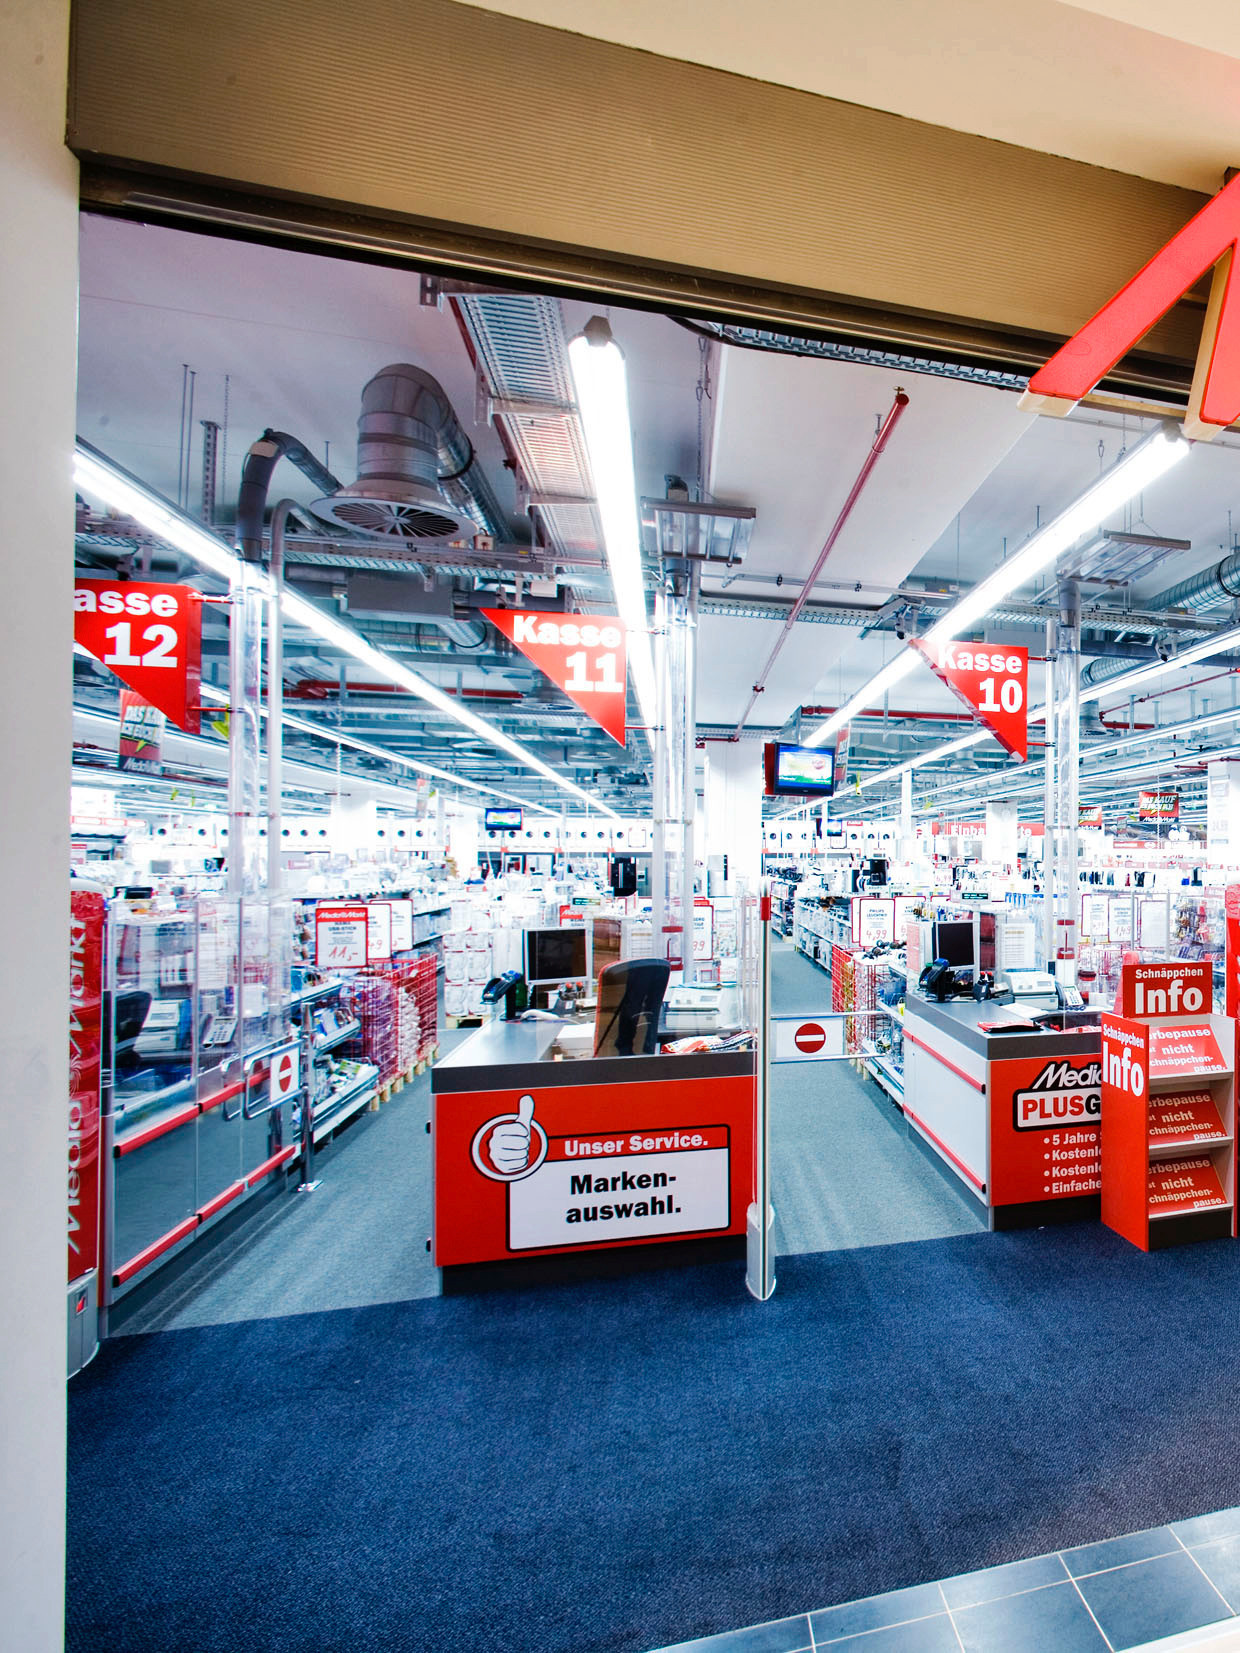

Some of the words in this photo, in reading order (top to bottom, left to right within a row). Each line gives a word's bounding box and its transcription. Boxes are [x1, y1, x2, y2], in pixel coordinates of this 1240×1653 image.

[74, 588, 179, 617] asse
[512, 613, 622, 649] Kasse
[104, 621, 178, 668] 12
[937, 641, 1023, 674] Kasse
[563, 651, 625, 693] 11
[977, 675, 1025, 714] 10
[1135, 967, 1204, 980] Schnäppchen
[1135, 979, 1204, 1014] Info
[1103, 1023, 1145, 1049] Schnäppchen
[1149, 1027, 1211, 1041] erbepause
[1149, 1054, 1214, 1067] chnäppchen-
[1161, 1043, 1195, 1055] nicht
[1102, 1041, 1145, 1097] Info
[1022, 1094, 1102, 1121] PLUSG
[1148, 1093, 1211, 1109] erbepause
[1149, 1122, 1214, 1135] chnäppchen-
[1161, 1110, 1195, 1123] nicht
[564, 1136, 625, 1157] Unser
[629, 1131, 710, 1153] Service.
[1052, 1134, 1060, 1145] 5
[1063, 1132, 1097, 1145] Jahre
[1148, 1158, 1211, 1175] erbepause
[569, 1170, 678, 1195] Marken-
[1161, 1177, 1195, 1190] nicht
[1149, 1188, 1213, 1204] chnäppchen-
[565, 1193, 683, 1225] auswahl.
